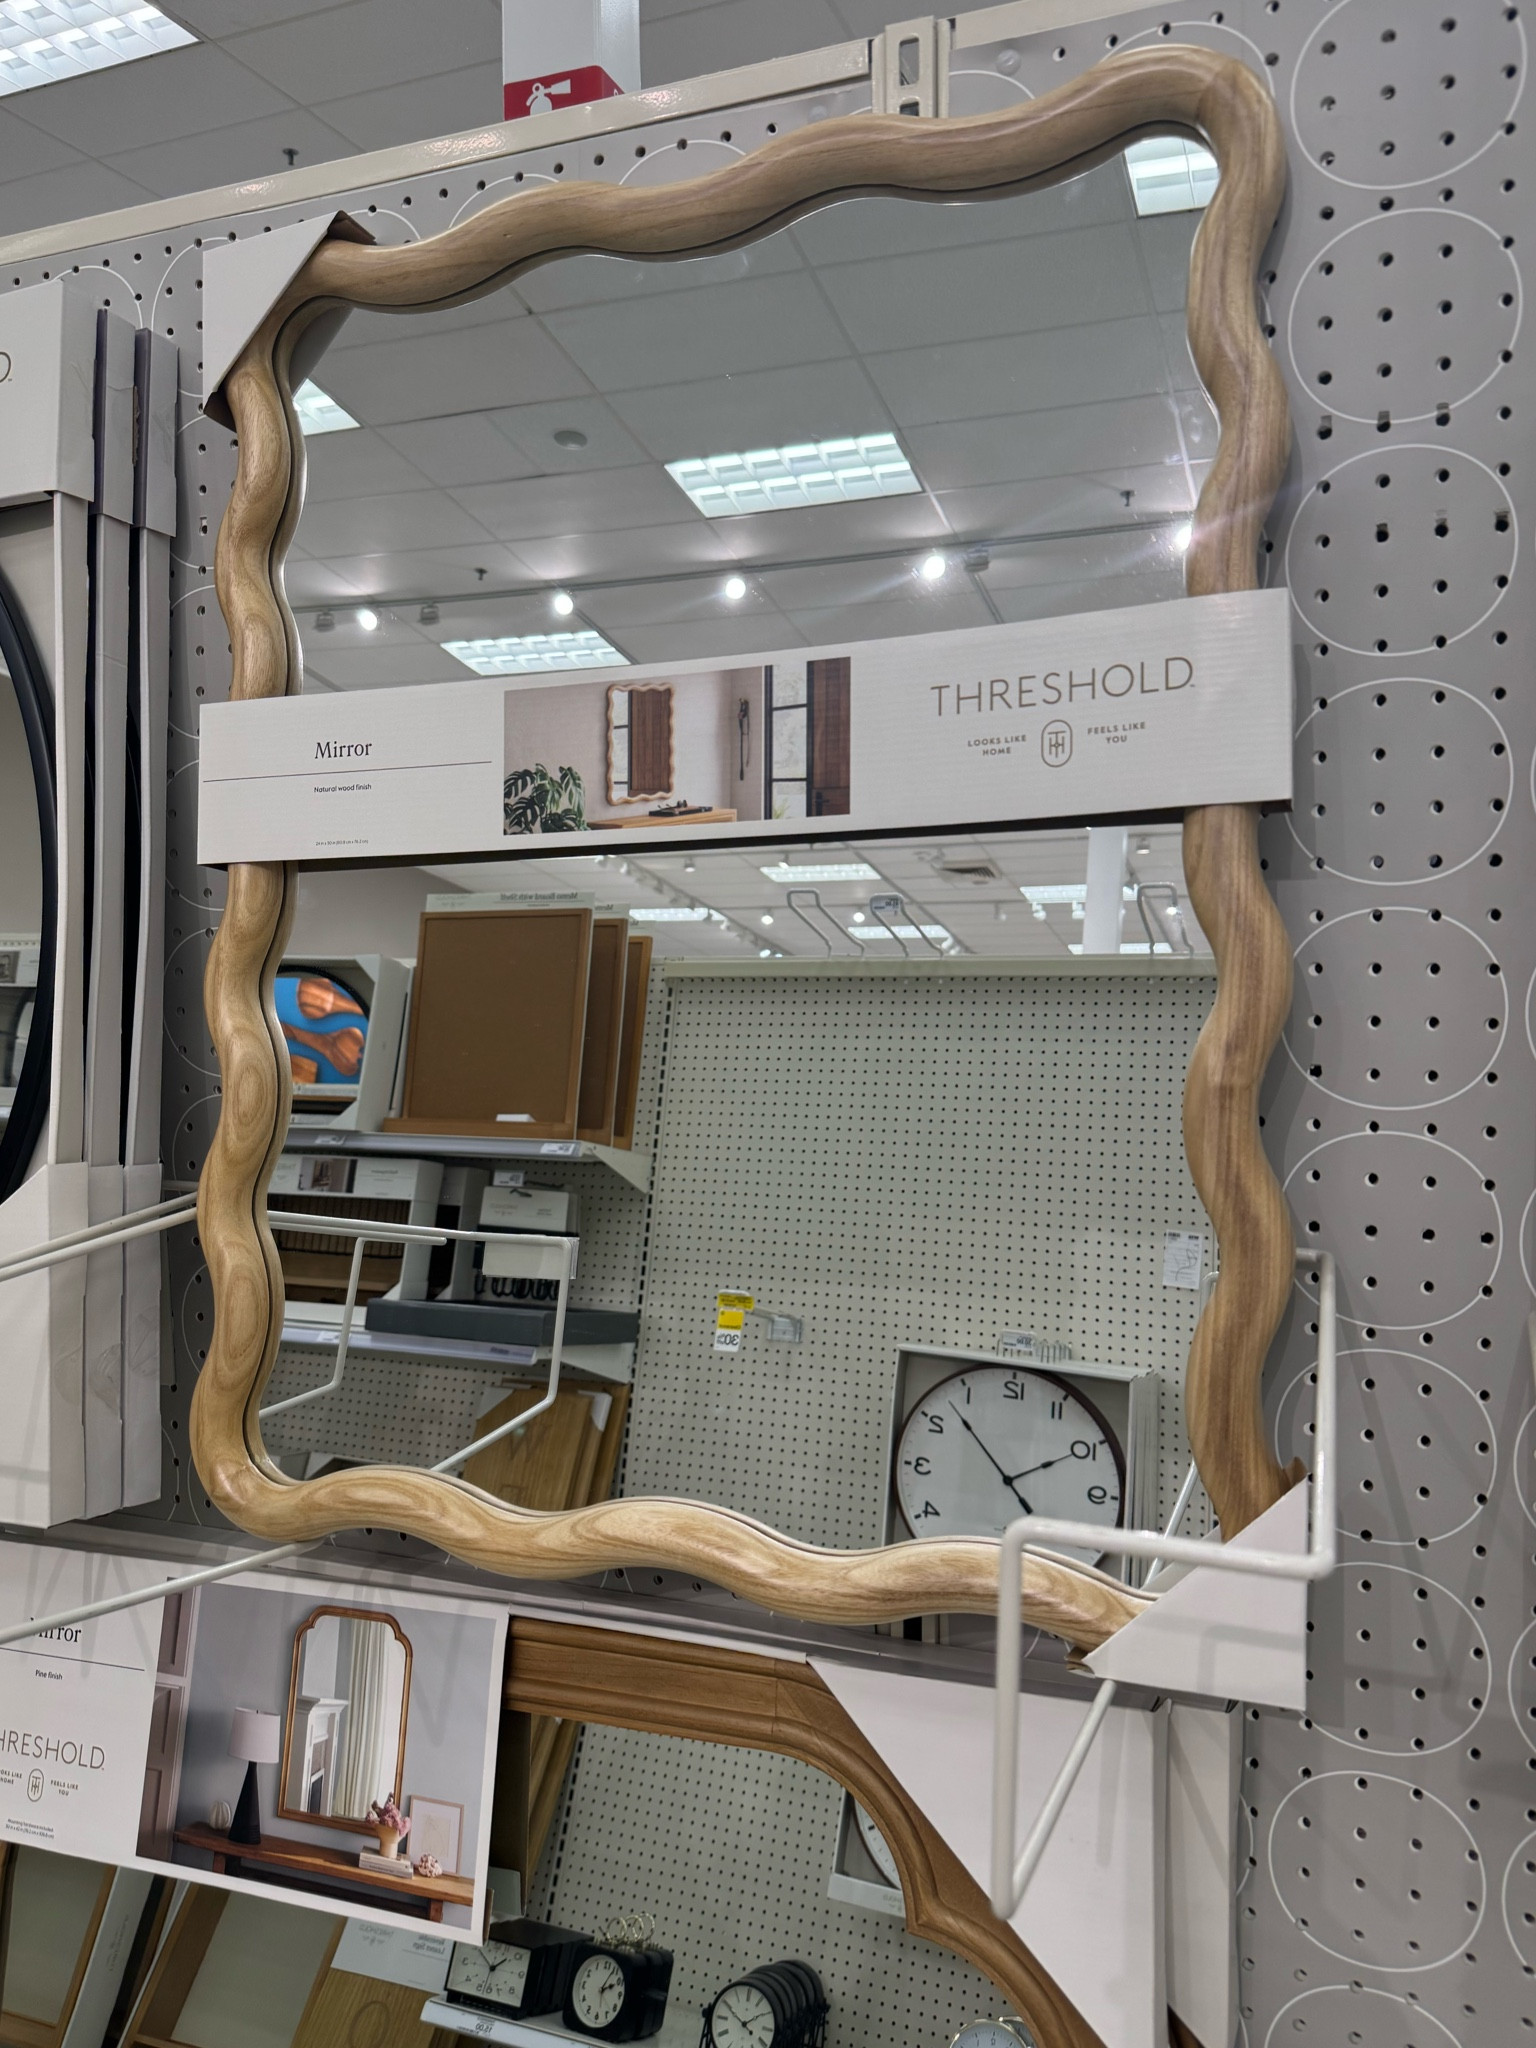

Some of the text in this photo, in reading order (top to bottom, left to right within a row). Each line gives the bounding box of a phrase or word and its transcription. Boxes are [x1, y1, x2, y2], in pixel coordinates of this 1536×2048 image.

[930, 657, 1194, 716] THRESHOLD
[1087, 721, 1146, 735] FEELS LIKE
[968, 734, 1027, 747] LOOKS LIKE
[1105, 735, 1128, 744] YOU
[315, 741, 372, 759] Mirror
[982, 746, 1012, 756] HOME
[314, 783, 372, 793] Natural wood finish
[35, 1669, 63, 1680] Pine finish
[11, 1771, 22, 1779] LIKE
[50, 1779, 79, 1790] FEELS LIKE
